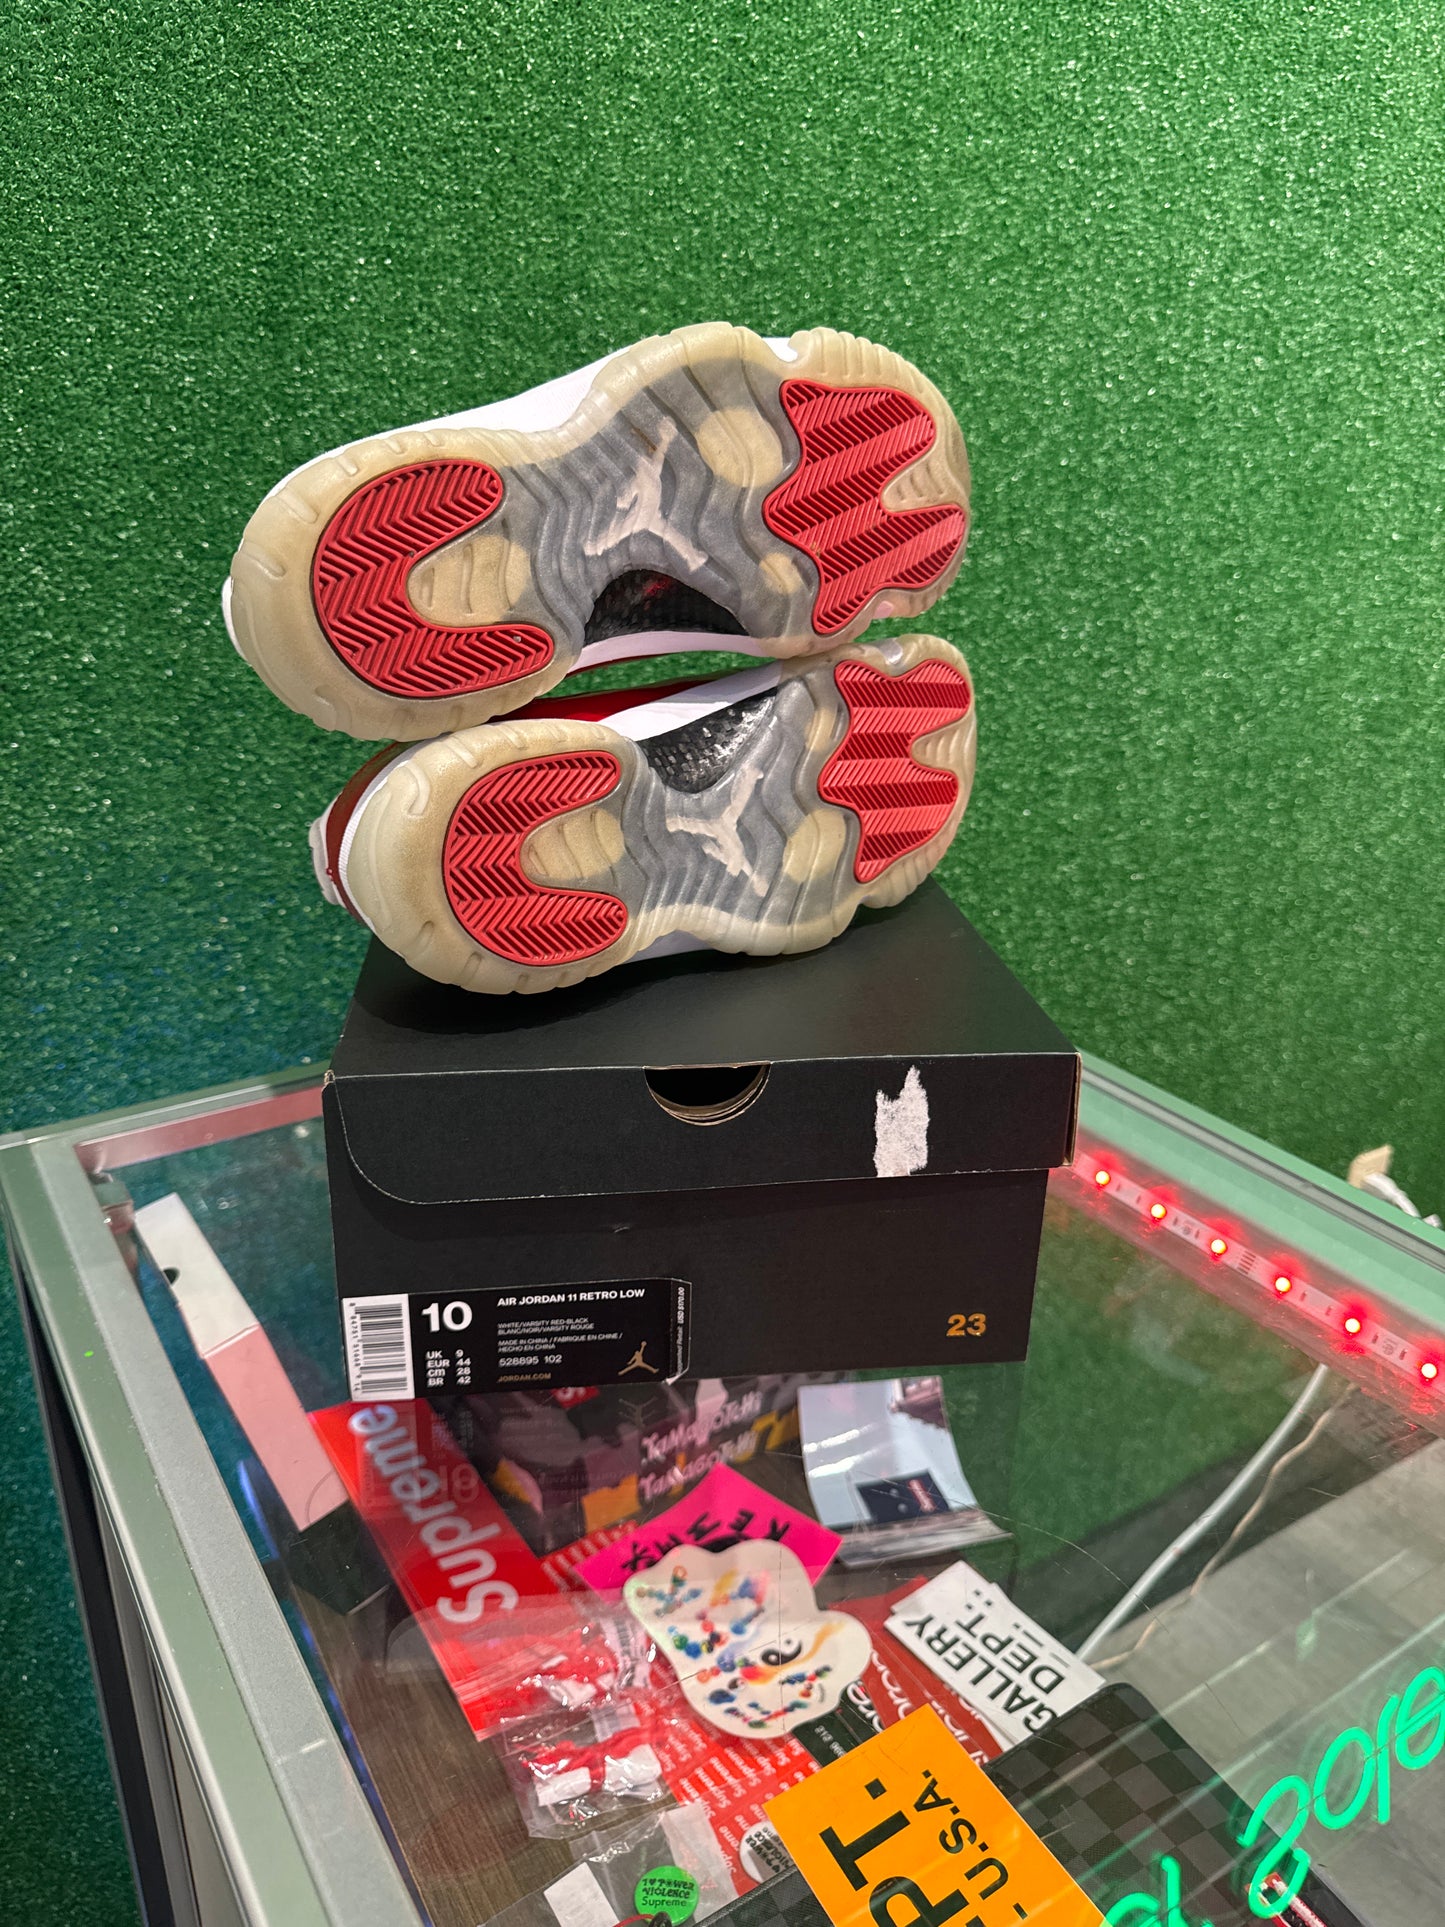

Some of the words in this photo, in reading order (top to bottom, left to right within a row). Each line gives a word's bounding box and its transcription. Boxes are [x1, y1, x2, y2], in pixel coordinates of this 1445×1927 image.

[497, 1298, 517, 1307] AIR
[518, 1294, 565, 1306] JORDAN
[567, 1293, 577, 1302] 11
[579, 1290, 618, 1301] RETRO
[619, 1289, 646, 1299] LOW
[421, 1300, 473, 1333] 10
[550, 1317, 589, 1326] RED-BLACK
[946, 1313, 986, 1336] 23
[426, 1350, 443, 1360] UK
[455, 1349, 464, 1359] 9
[427, 1359, 450, 1369] EUR
[456, 1358, 471, 1367] 44
[499, 1356, 540, 1367] 528895
[544, 1354, 563, 1365] 102
[428, 1377, 444, 1387] BR
[456, 1376, 471, 1385] 42
[456, 1367, 471, 1376] 28
[497, 1373, 552, 1383] JORDAN.COM
[348, 1404, 519, 1624] Supreme
[904, 1614, 1060, 1733] GALLERY
[709, 1756, 746, 1798] Supreme
[724, 1747, 761, 1787] Supreme
[694, 1767, 731, 1809] Supreme
[914, 1769, 1008, 1901] U.S.A.
[819, 1778, 976, 1927] PT.
[641, 1896, 687, 1908] Supreme
